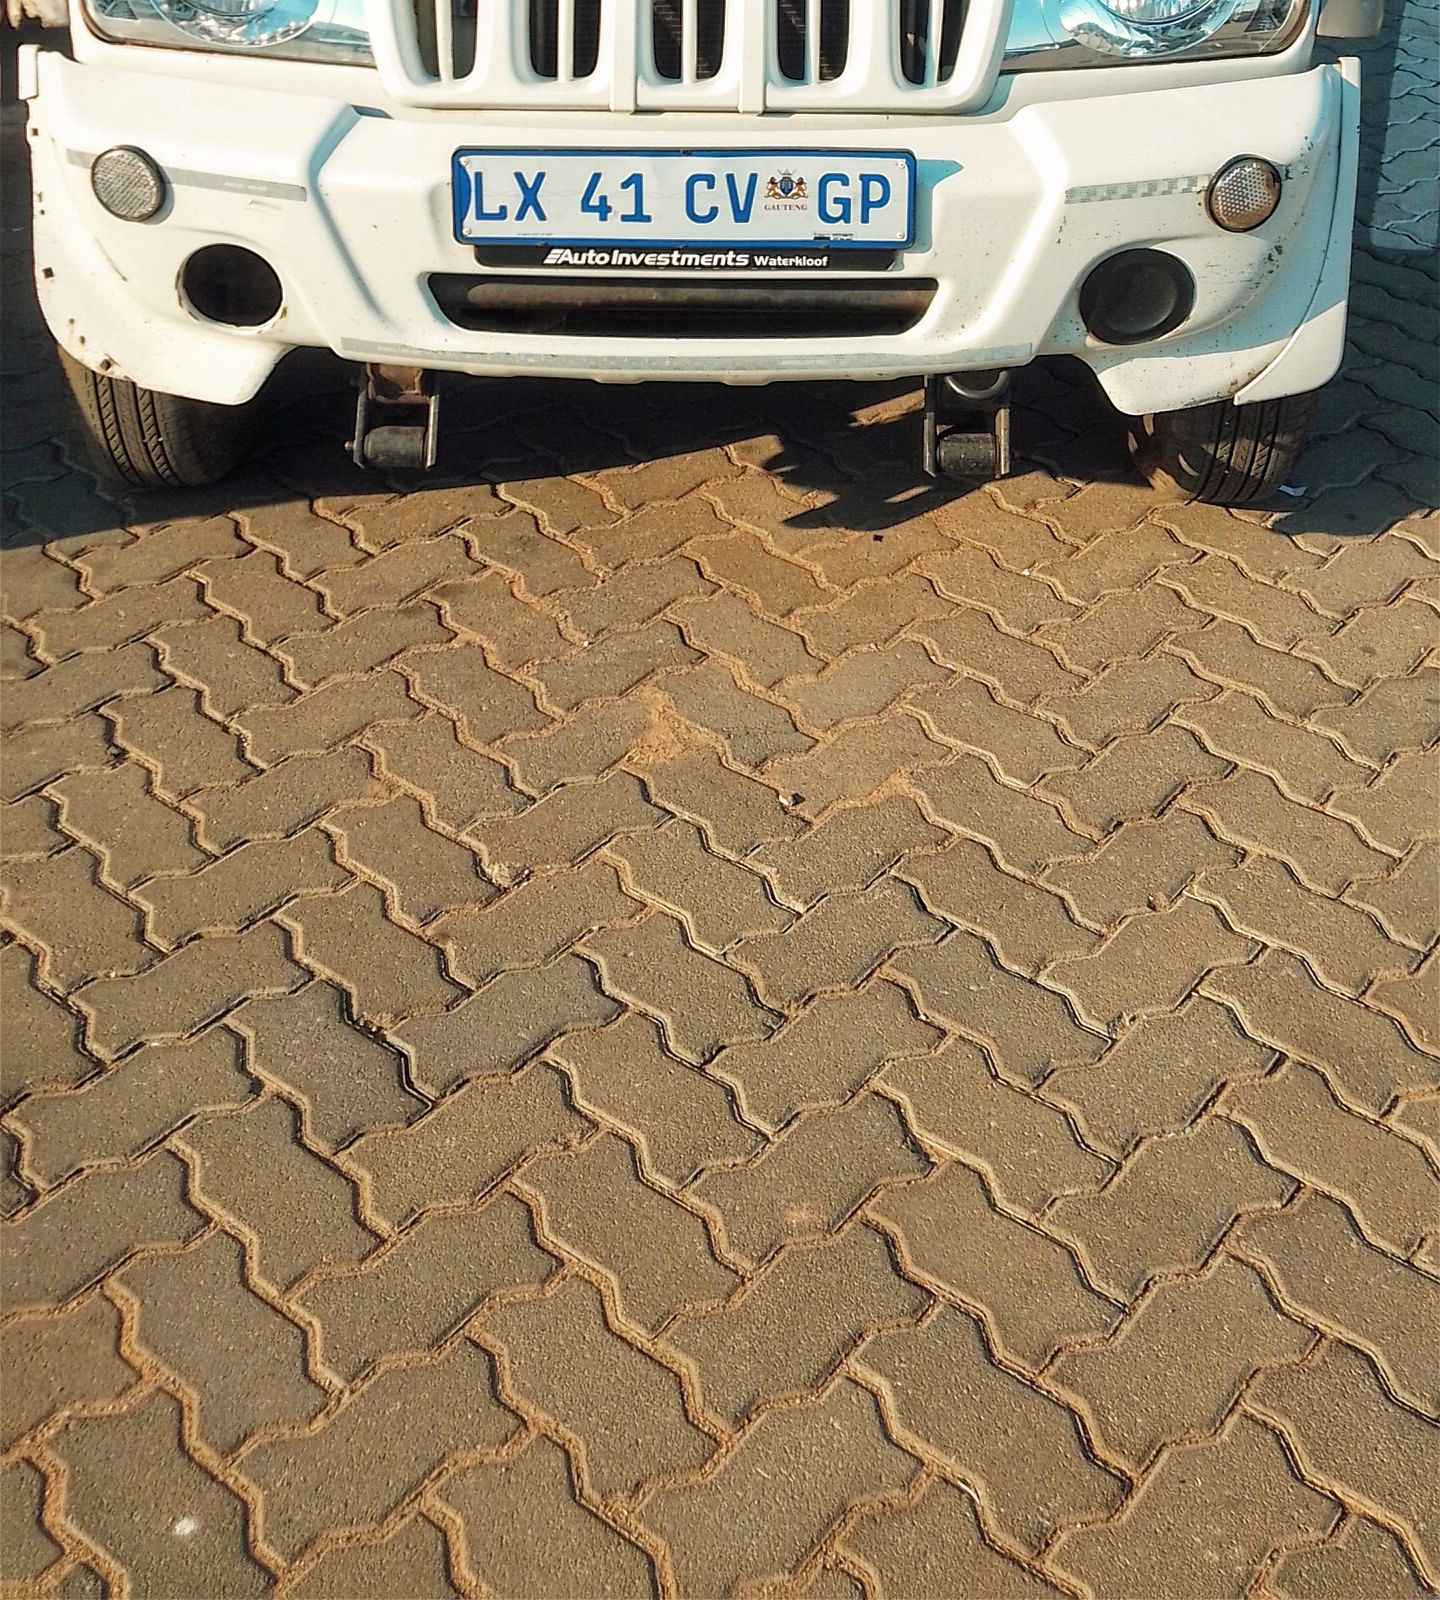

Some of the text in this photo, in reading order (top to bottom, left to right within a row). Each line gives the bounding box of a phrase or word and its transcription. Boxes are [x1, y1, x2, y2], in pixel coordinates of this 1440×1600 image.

[474, 171, 891, 225] LX 41 CV GP
[754, 255, 829, 267] Waterkloof
